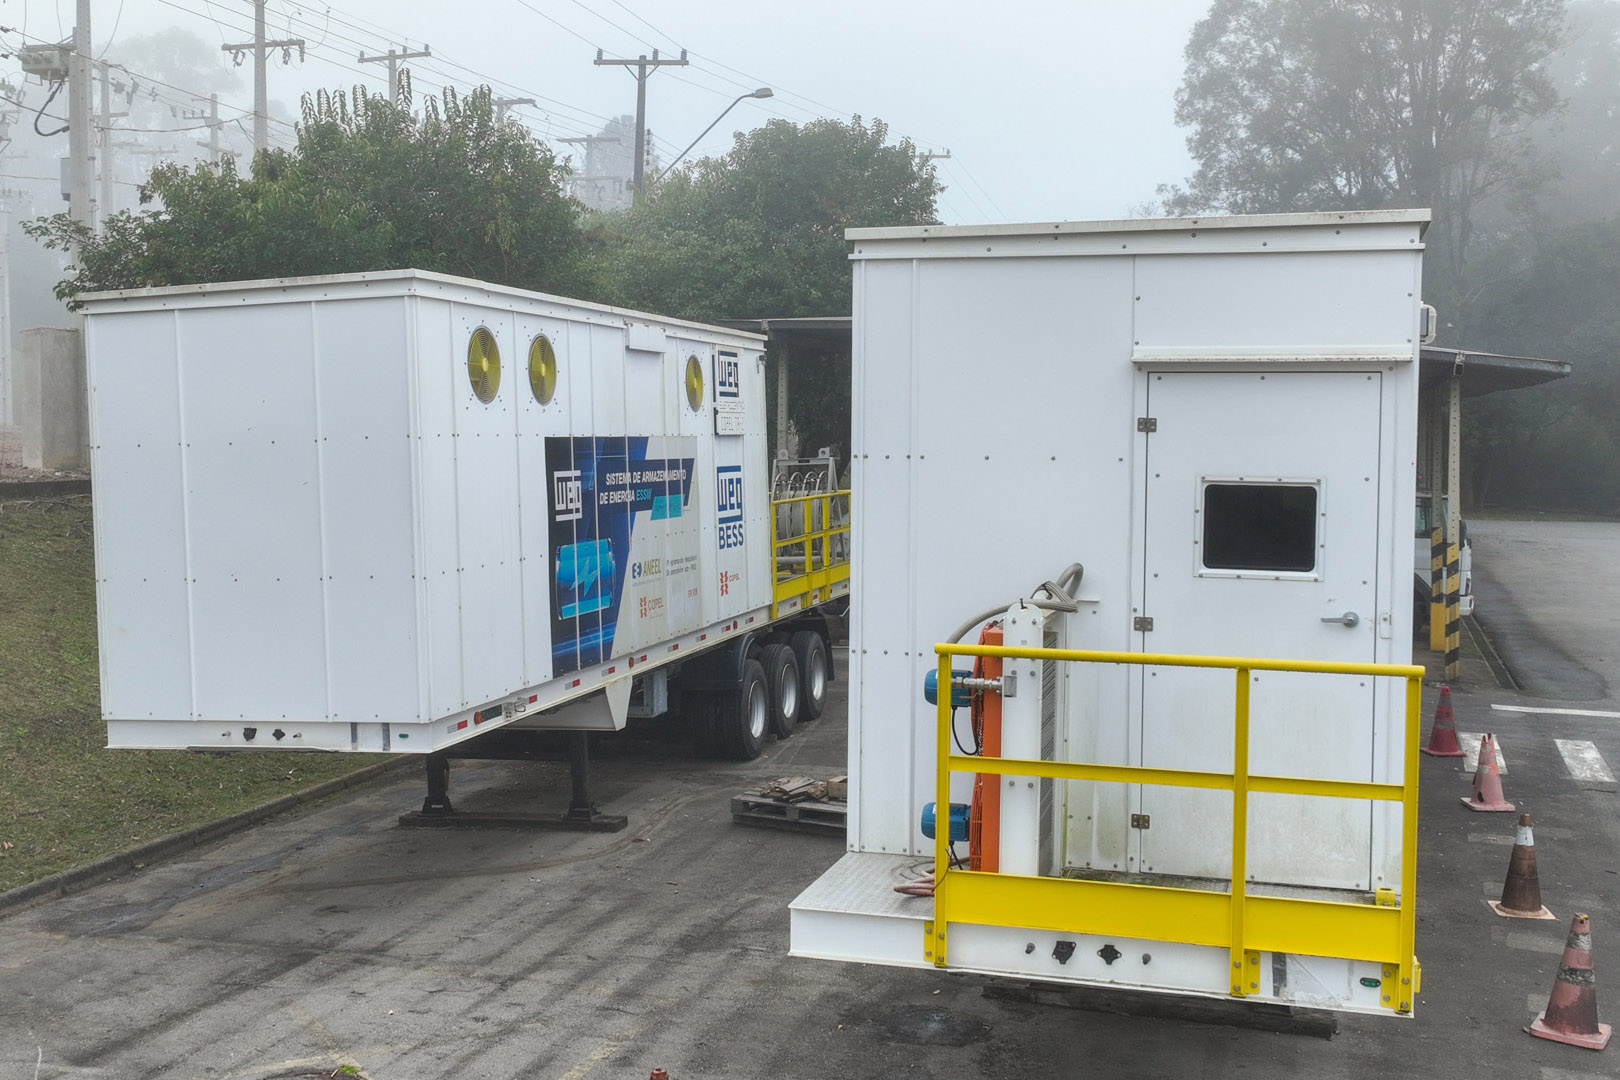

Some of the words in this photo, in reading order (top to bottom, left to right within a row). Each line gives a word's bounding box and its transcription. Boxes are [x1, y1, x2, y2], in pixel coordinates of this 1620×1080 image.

[605, 471, 633, 486] SISTEMA
[633, 471, 641, 484] DE
[600, 491, 609, 505] DE
[718, 523, 744, 550] BESS
[643, 558, 662, 577] ANEEL
[647, 597, 665, 611] COPEL
